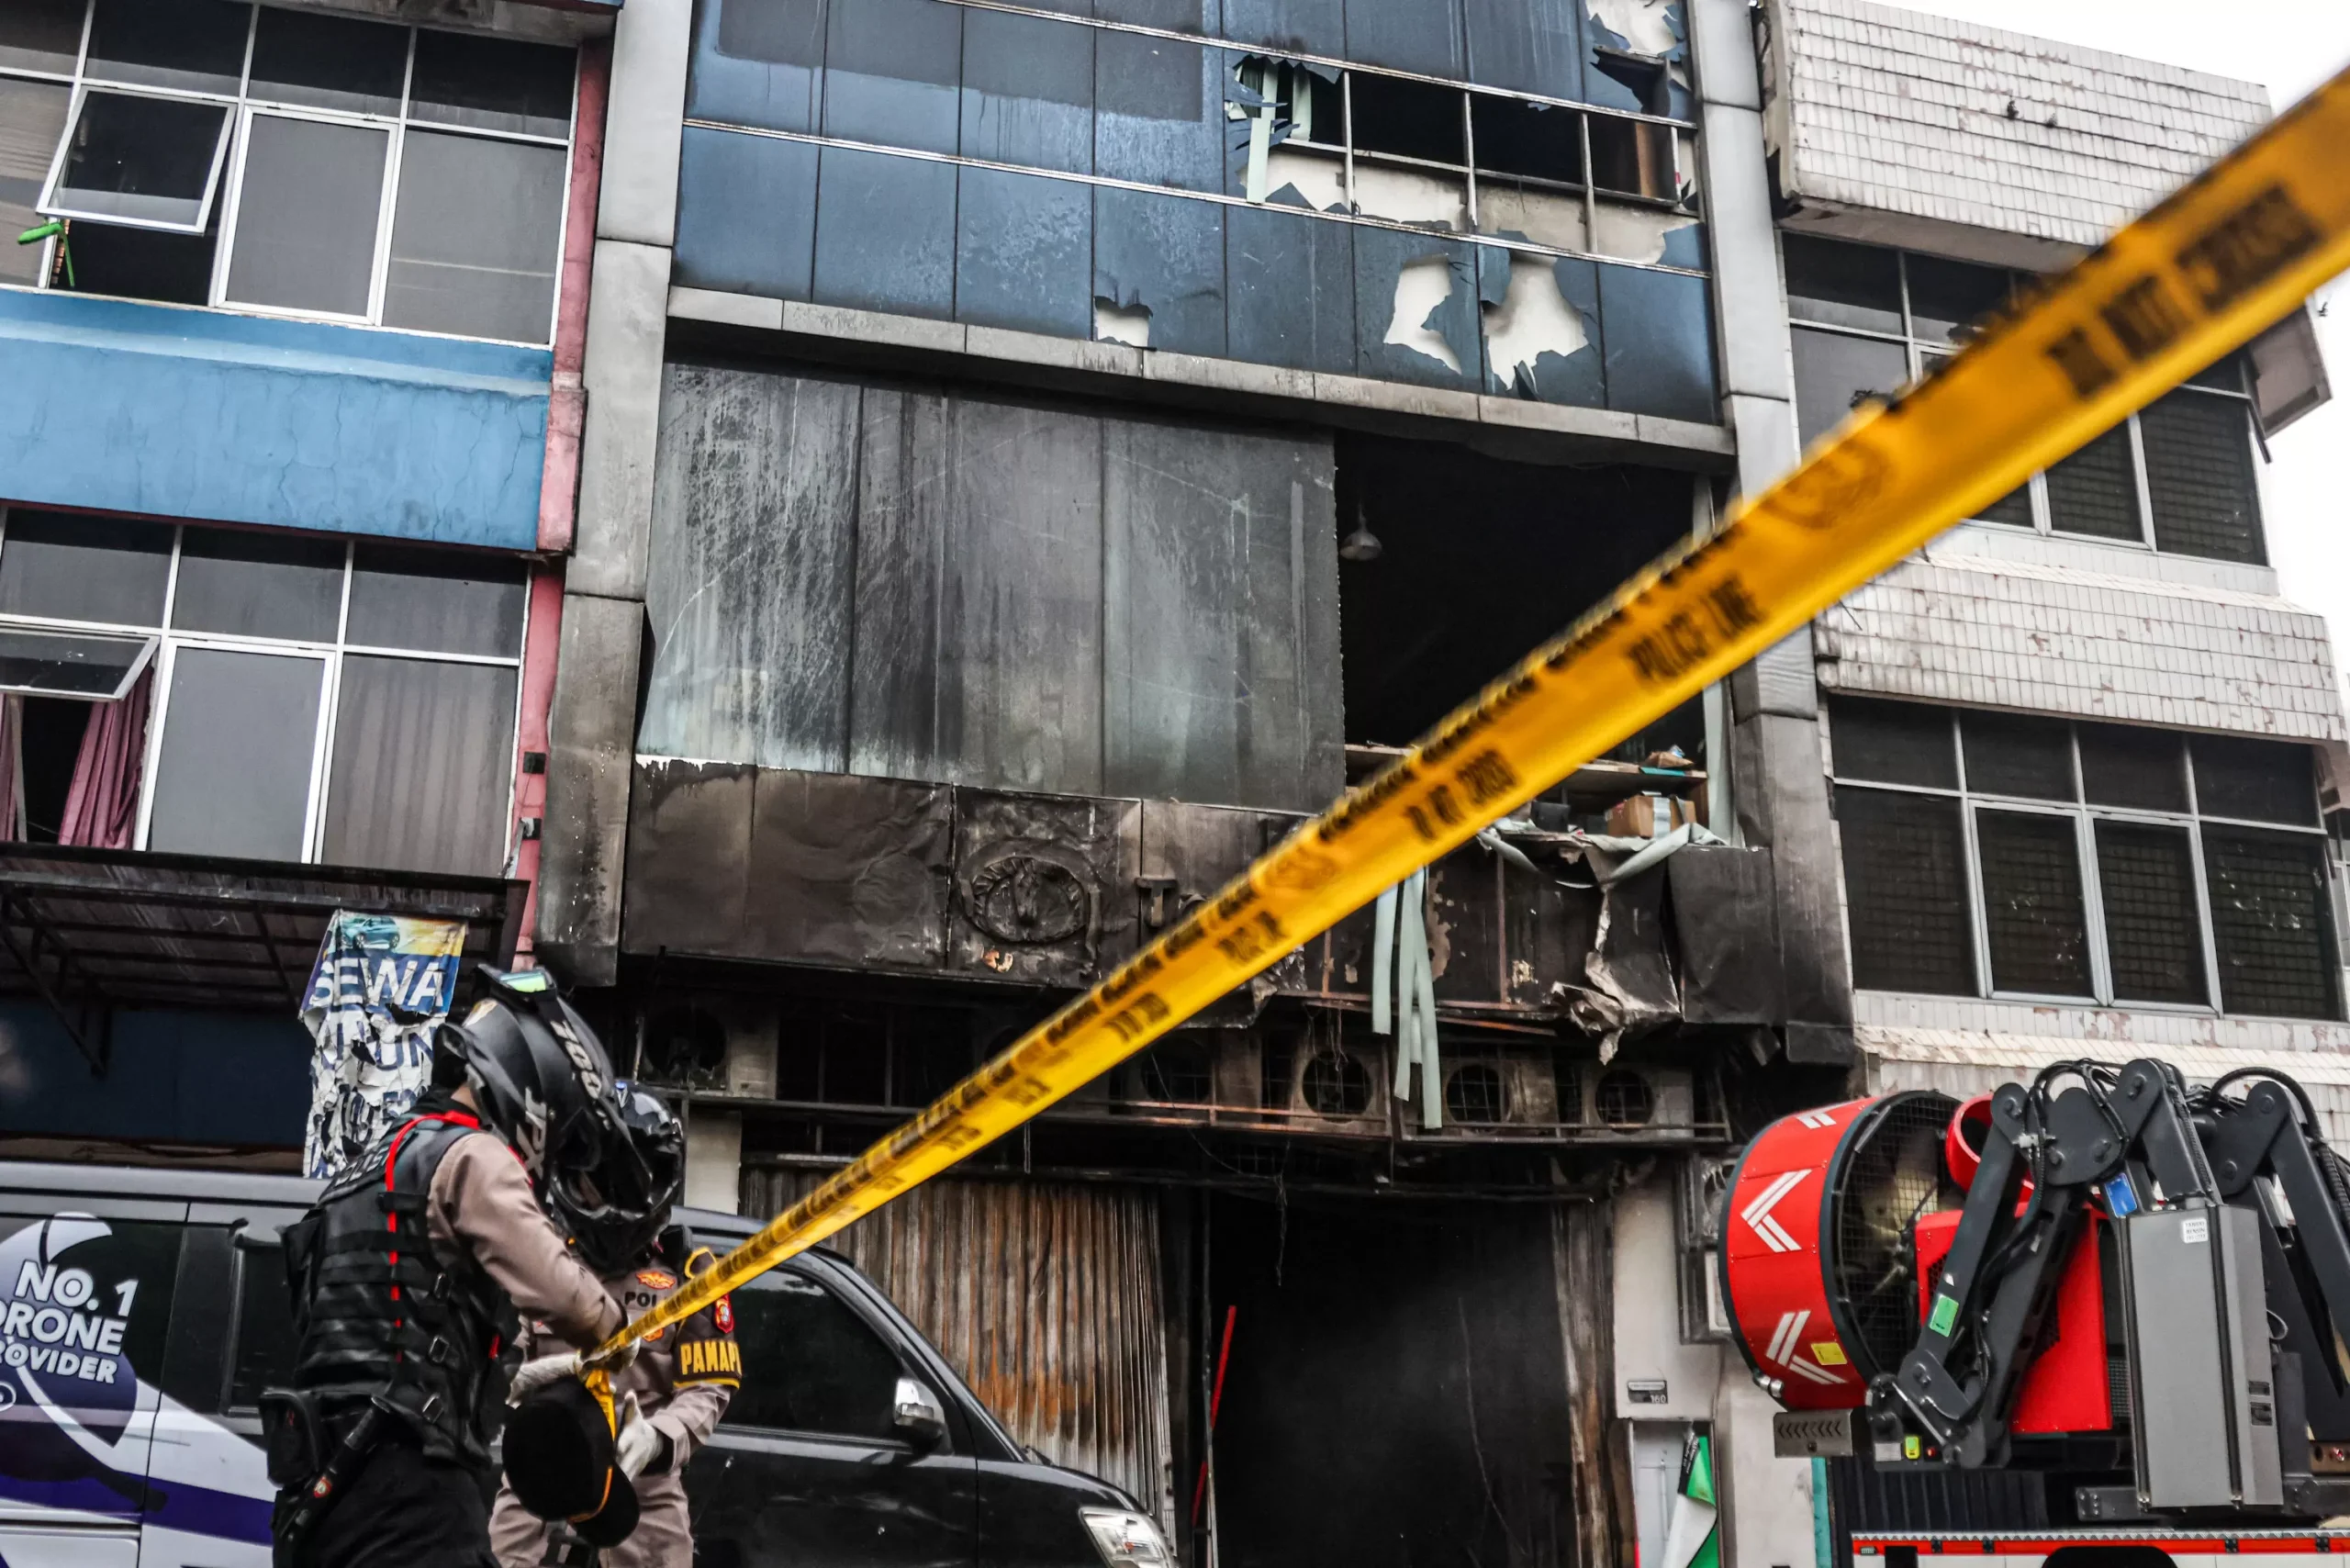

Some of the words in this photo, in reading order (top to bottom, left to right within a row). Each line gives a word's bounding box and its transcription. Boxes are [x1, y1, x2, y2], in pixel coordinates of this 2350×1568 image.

[310, 958, 445, 1007] SEWA
[15, 1260, 99, 1311] NO.
[115, 1279, 139, 1317] 1
